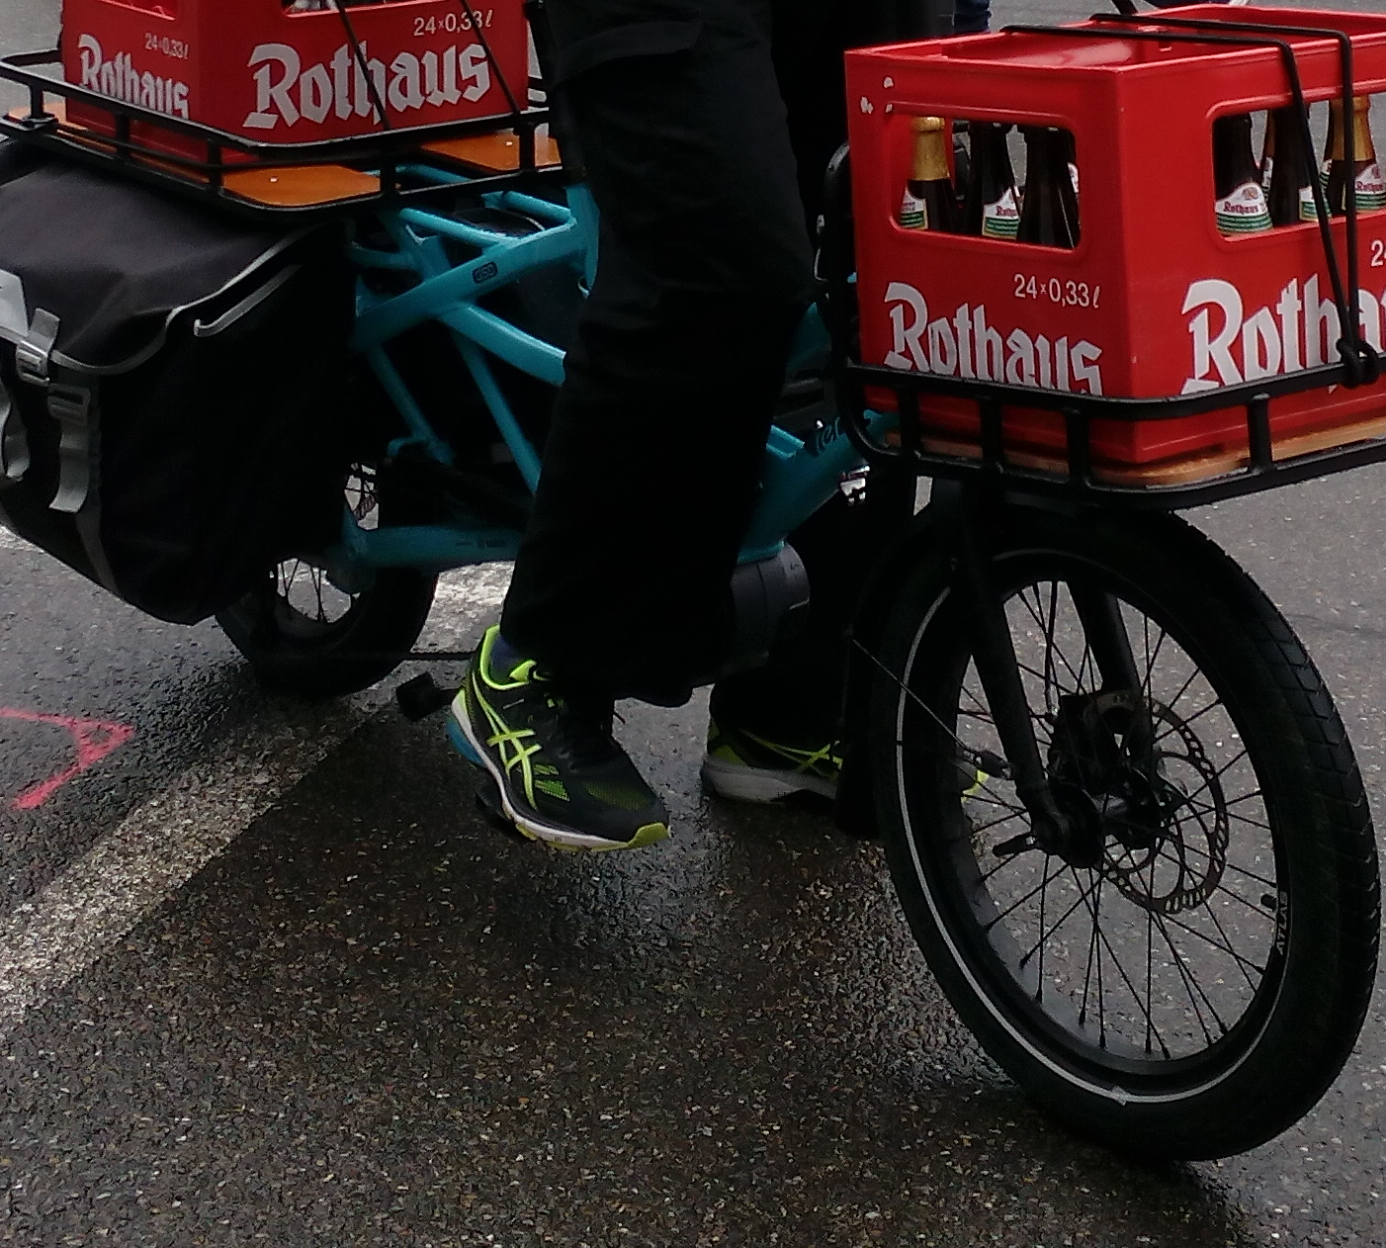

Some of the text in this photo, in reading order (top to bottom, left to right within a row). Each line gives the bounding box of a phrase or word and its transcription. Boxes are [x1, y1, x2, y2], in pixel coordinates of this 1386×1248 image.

[78, 34, 191, 121] Rothaus
[243, 41, 494, 130] Rothaus
[1223, 201, 1259, 215] Rothaus
[883, 281, 1103, 396] Rothaus
